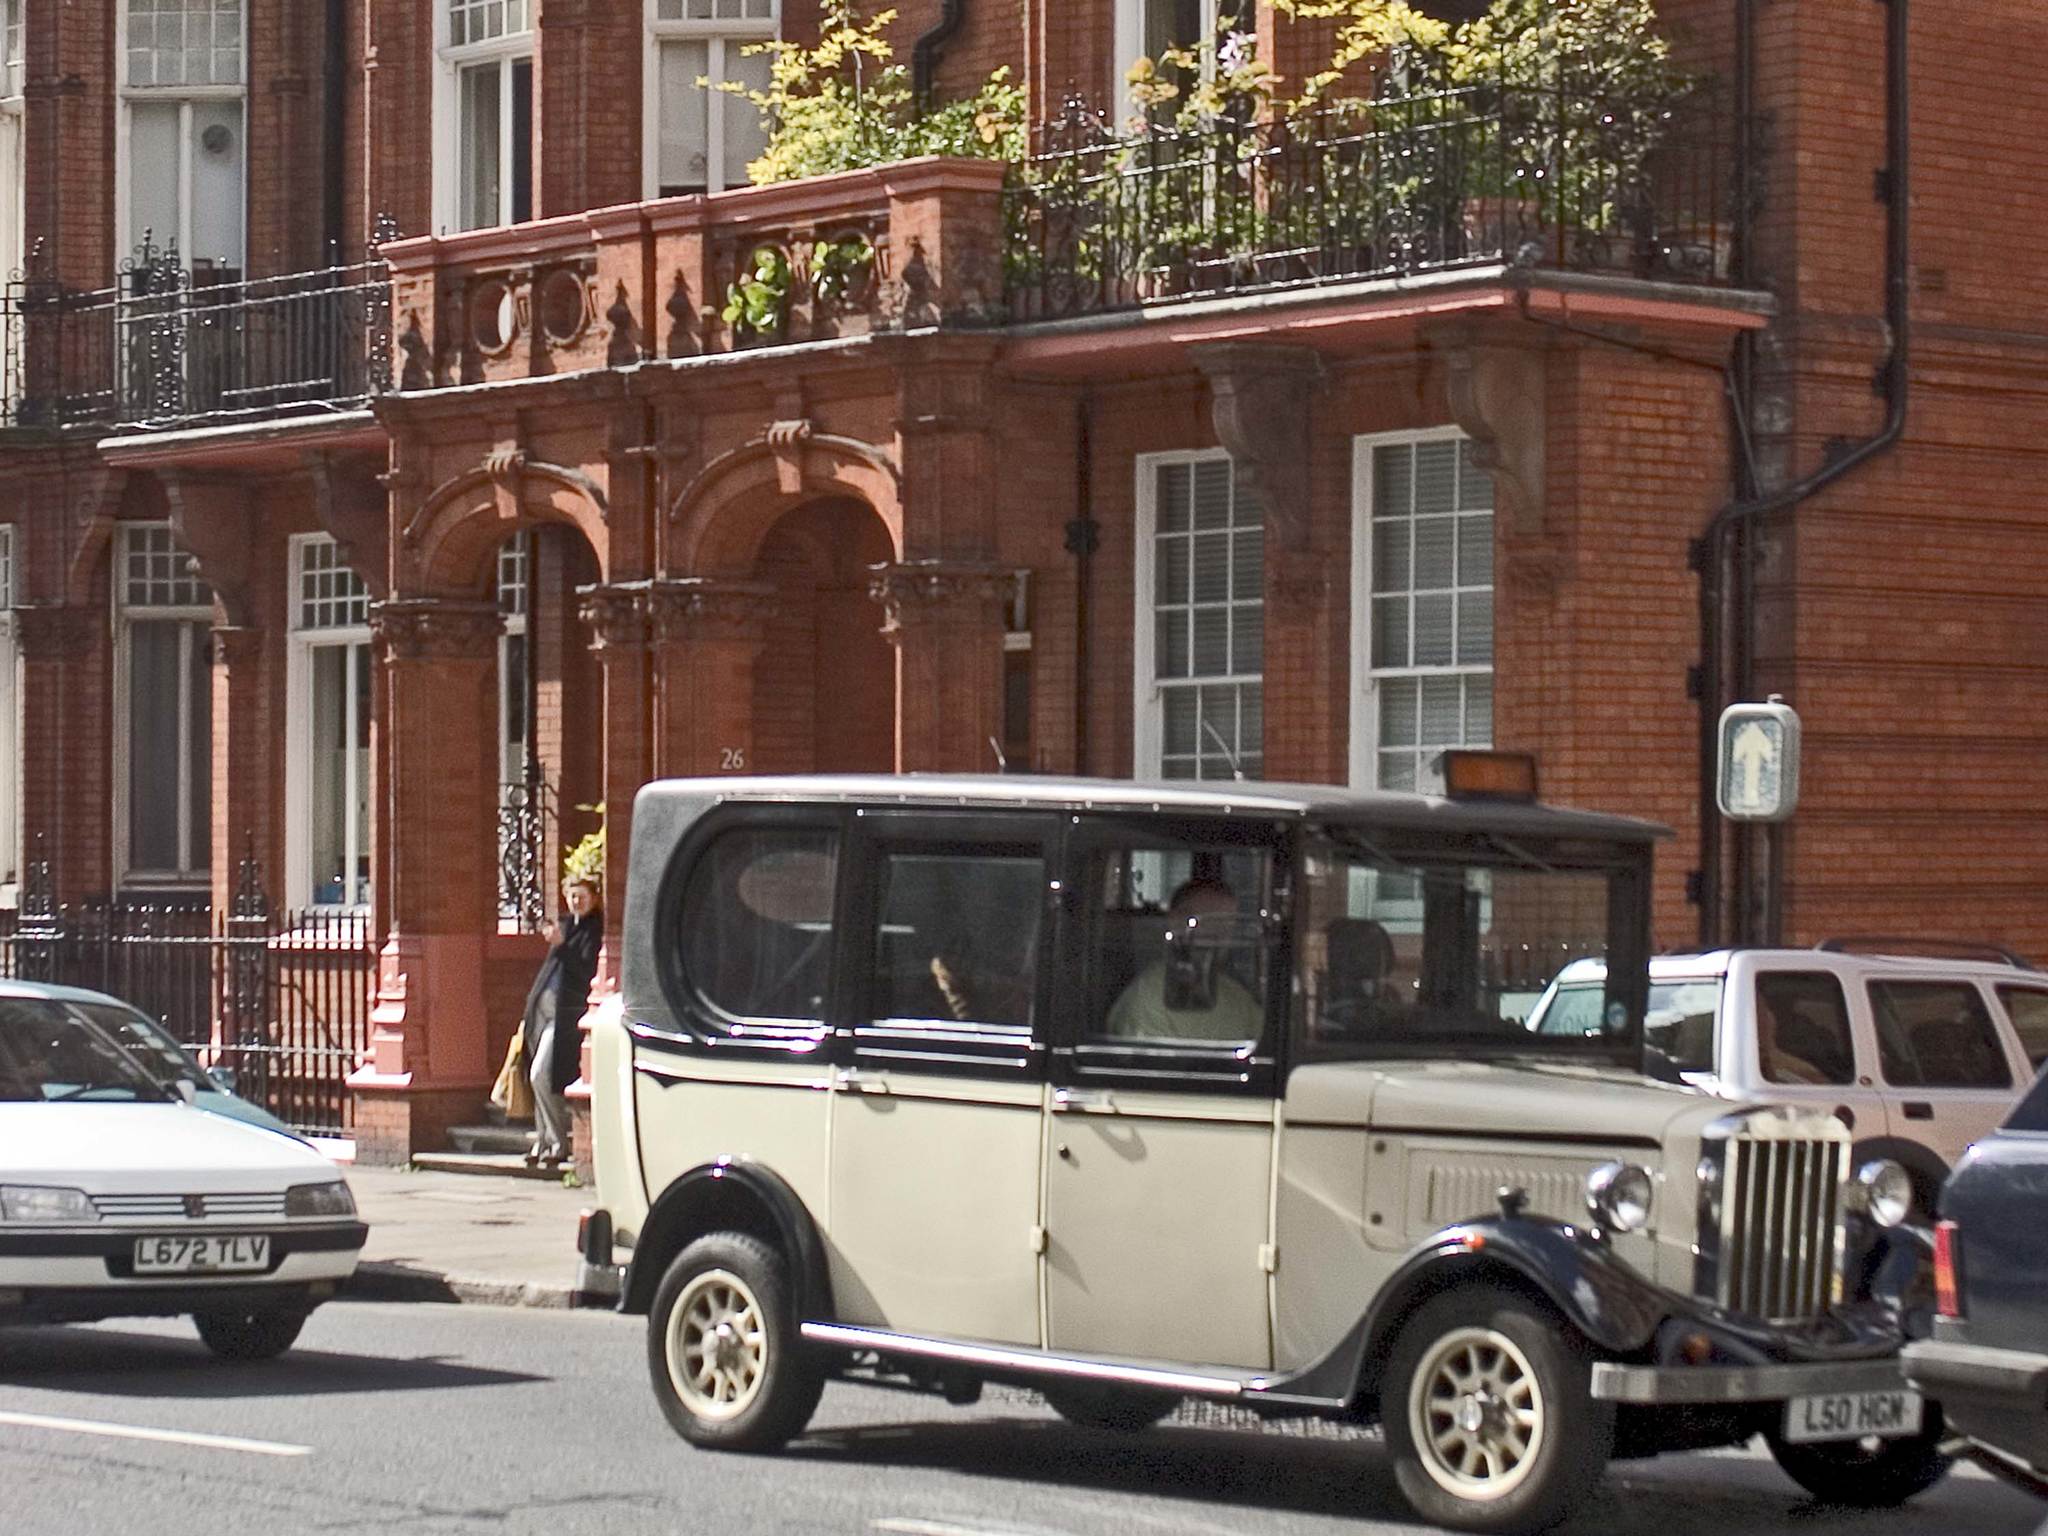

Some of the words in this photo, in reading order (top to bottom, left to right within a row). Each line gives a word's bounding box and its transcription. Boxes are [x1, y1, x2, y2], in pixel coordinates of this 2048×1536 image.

[720, 747, 745, 770] 26
[137, 1237, 208, 1265] L672
[215, 1237, 266, 1263] TLV
